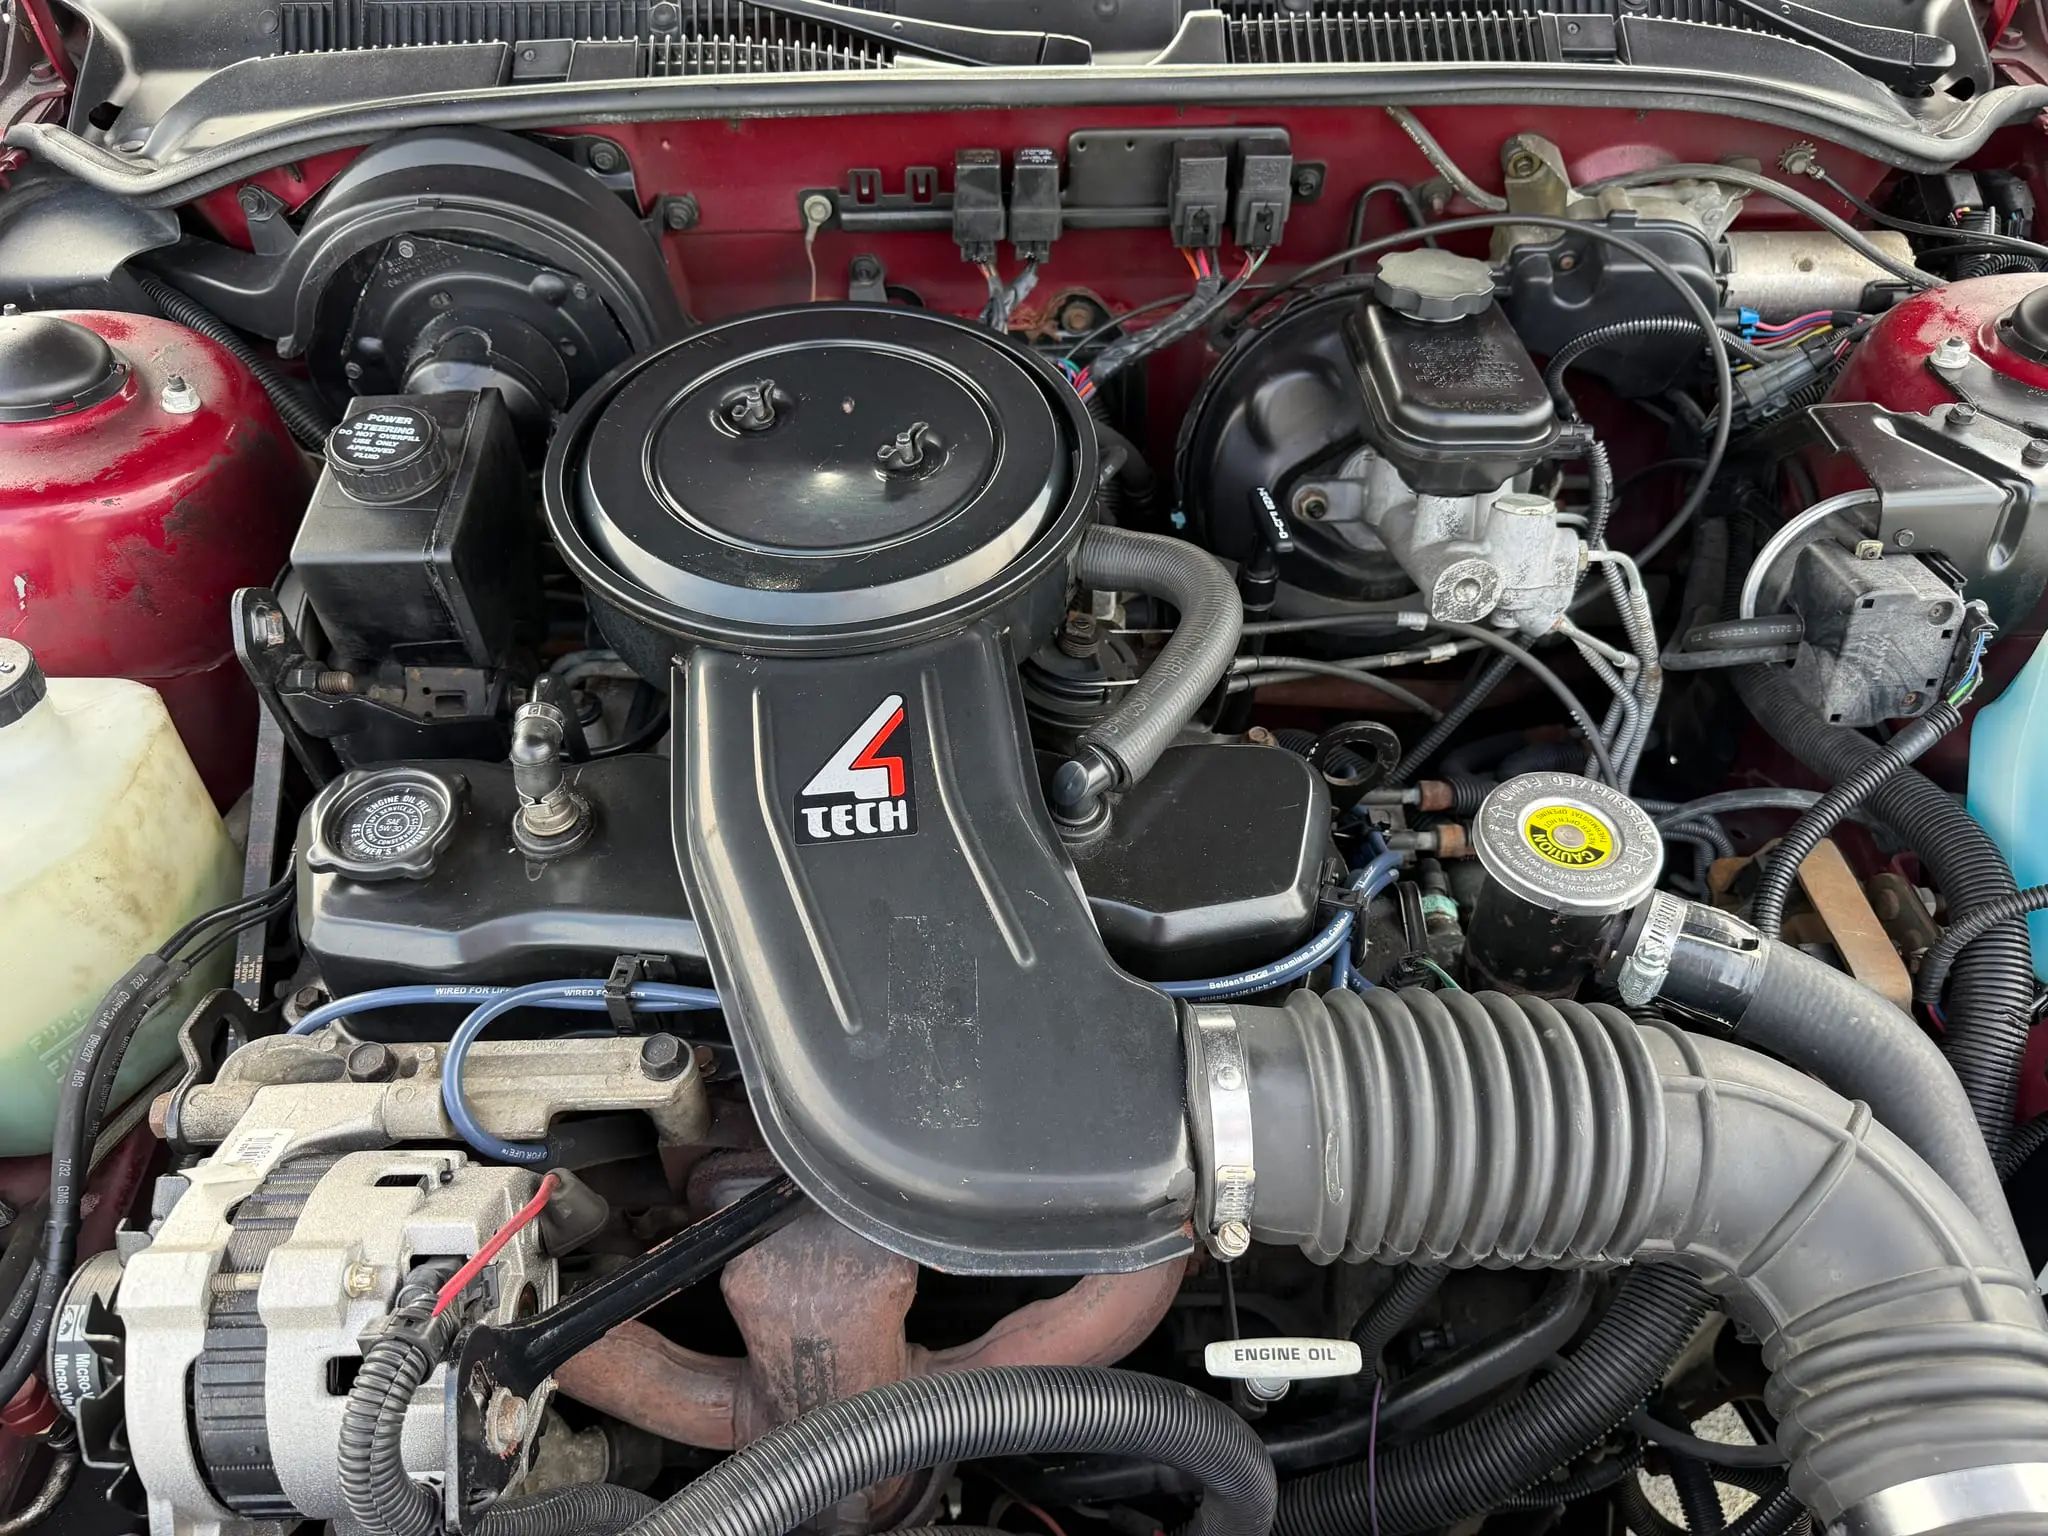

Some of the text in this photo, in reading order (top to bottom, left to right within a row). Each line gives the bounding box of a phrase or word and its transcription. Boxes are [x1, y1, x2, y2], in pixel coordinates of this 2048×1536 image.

[367, 413, 413, 425] POWER
[353, 422, 415, 435] STEERING
[375, 440, 400, 448] ONLY
[378, 433, 421, 442] OVERFILL
[346, 444, 396, 454] APPROVED
[353, 452, 380, 460] FLUID
[801, 694, 906, 800] 4
[365, 795, 432, 815] ENGINE OIL FILL
[1497, 775, 1656, 844] PRESSURIZED FLUID
[386, 818, 401, 826] SAE
[801, 799, 908, 838] TECH
[351, 823, 431, 856] SEE OWNER'S MANUAL
[1531, 832, 1596, 863] CAUTION
[129, 973, 148, 990] 7/32
[435, 986, 466, 996] WIRED
[469, 986, 490, 995] FOR
[563, 989, 608, 997] WIRED FO
[526, 1151, 542, 1160] FOR
[58, 1158, 72, 1178] 7/32
[1234, 1348, 1336, 1361] ENGINE OIL
